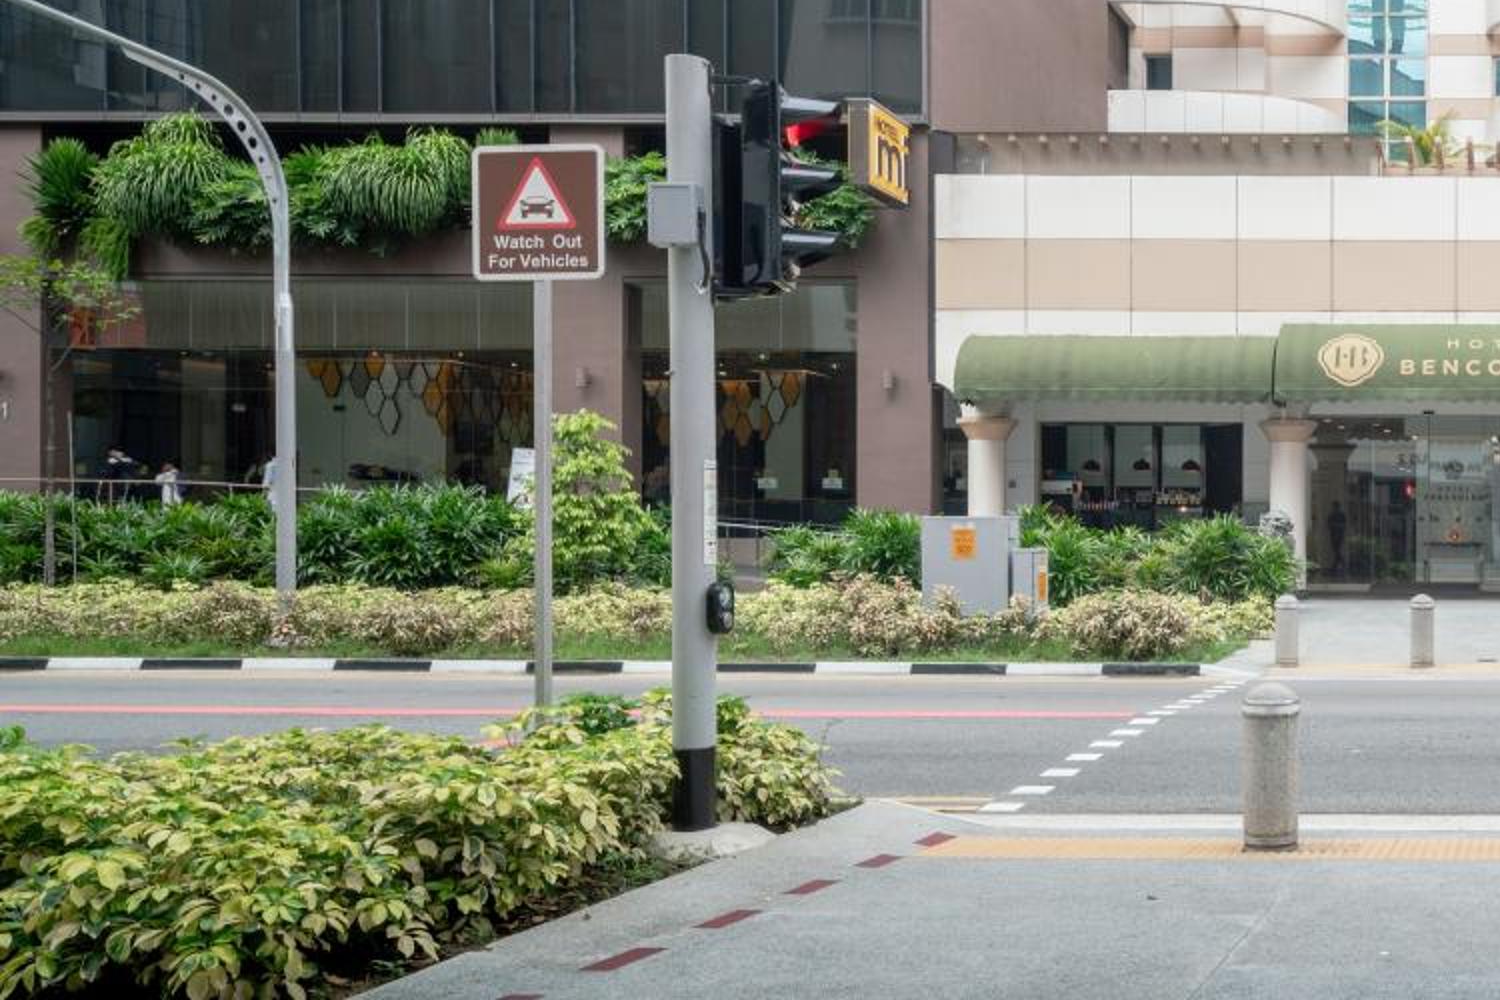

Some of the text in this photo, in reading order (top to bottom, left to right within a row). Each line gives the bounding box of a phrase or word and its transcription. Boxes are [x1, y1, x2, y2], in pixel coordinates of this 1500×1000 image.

[493, 233, 582, 249] Watch Out
[488, 253, 588, 269] For Vehicles
